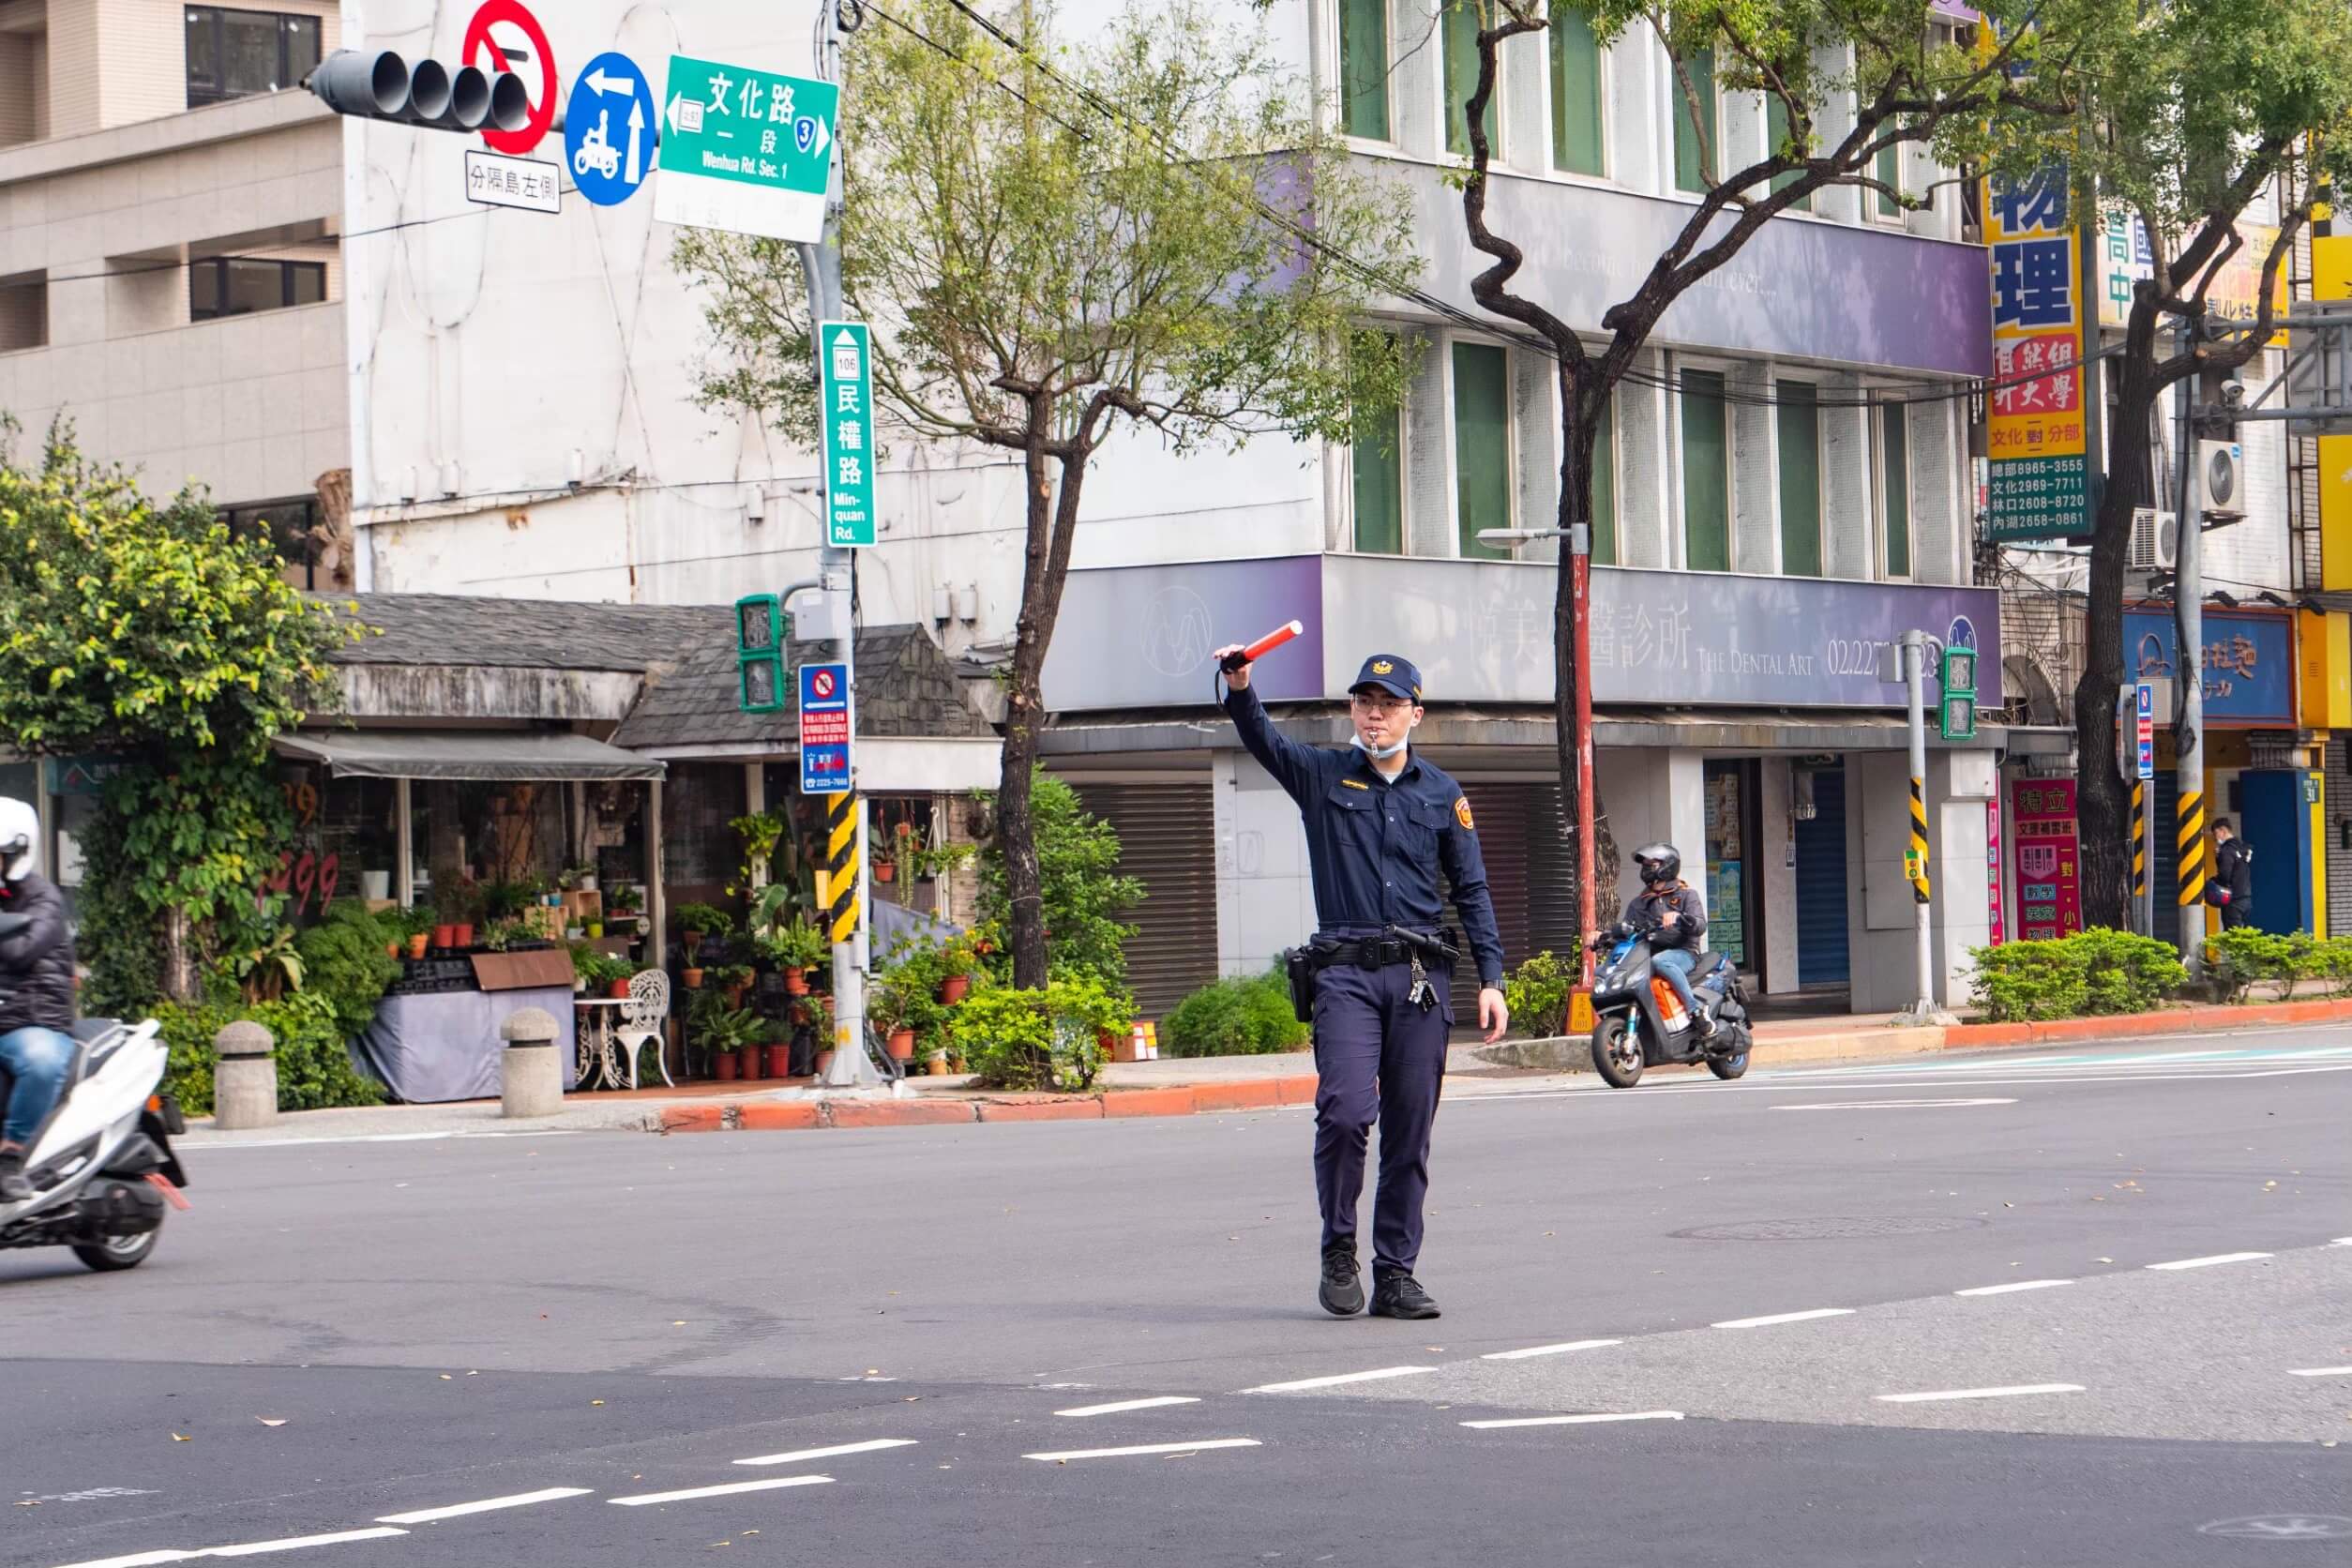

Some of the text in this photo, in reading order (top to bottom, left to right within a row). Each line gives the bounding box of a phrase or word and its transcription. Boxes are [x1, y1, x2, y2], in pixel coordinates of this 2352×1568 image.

[706, 72, 795, 125] 文化路
[716, 129, 776, 154] 一段
[799, 123, 810, 143] 3
[702, 150, 788, 179] Wenhua Rd. Sec. 1
[471, 165, 555, 200] 分隔島左側
[838, 357, 856, 371] 106
[1996, 341, 2072, 374] 自然組
[837, 384, 862, 486] 民權路
[1992, 427, 2023, 446] 文化
[2048, 423, 2080, 443] 分部
[834, 492, 861, 506] Min-
[835, 510, 865, 525] quan
[836, 526, 855, 541] Rd.
[1729, 649, 1785, 676] DENTAL
[1787, 652, 1815, 676] ART
